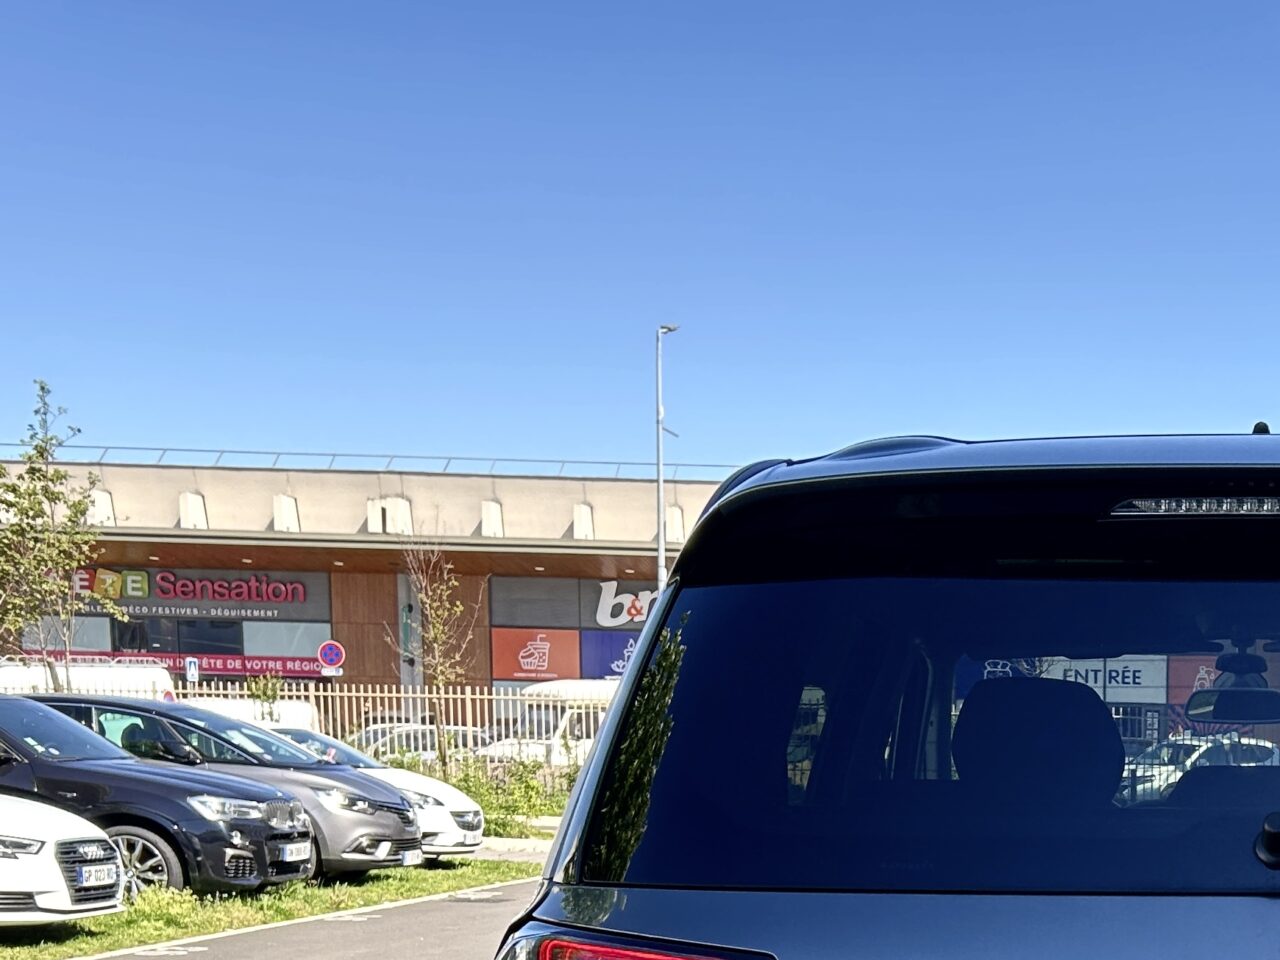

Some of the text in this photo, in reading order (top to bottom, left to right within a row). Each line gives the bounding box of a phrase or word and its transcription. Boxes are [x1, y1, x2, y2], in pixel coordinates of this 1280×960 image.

[64, 568, 306, 602] ÊTE Sensation
[152, 606, 199, 615] FESTIVES
[210, 607, 279, 617] DÉGUISEMENT
[198, 655, 224, 669] ÊTE
[227, 660, 242, 669] DE
[245, 660, 283, 671] VOTRE
[286, 659, 324, 672] RÉGIO
[1063, 666, 1142, 685] ENTRÉE
